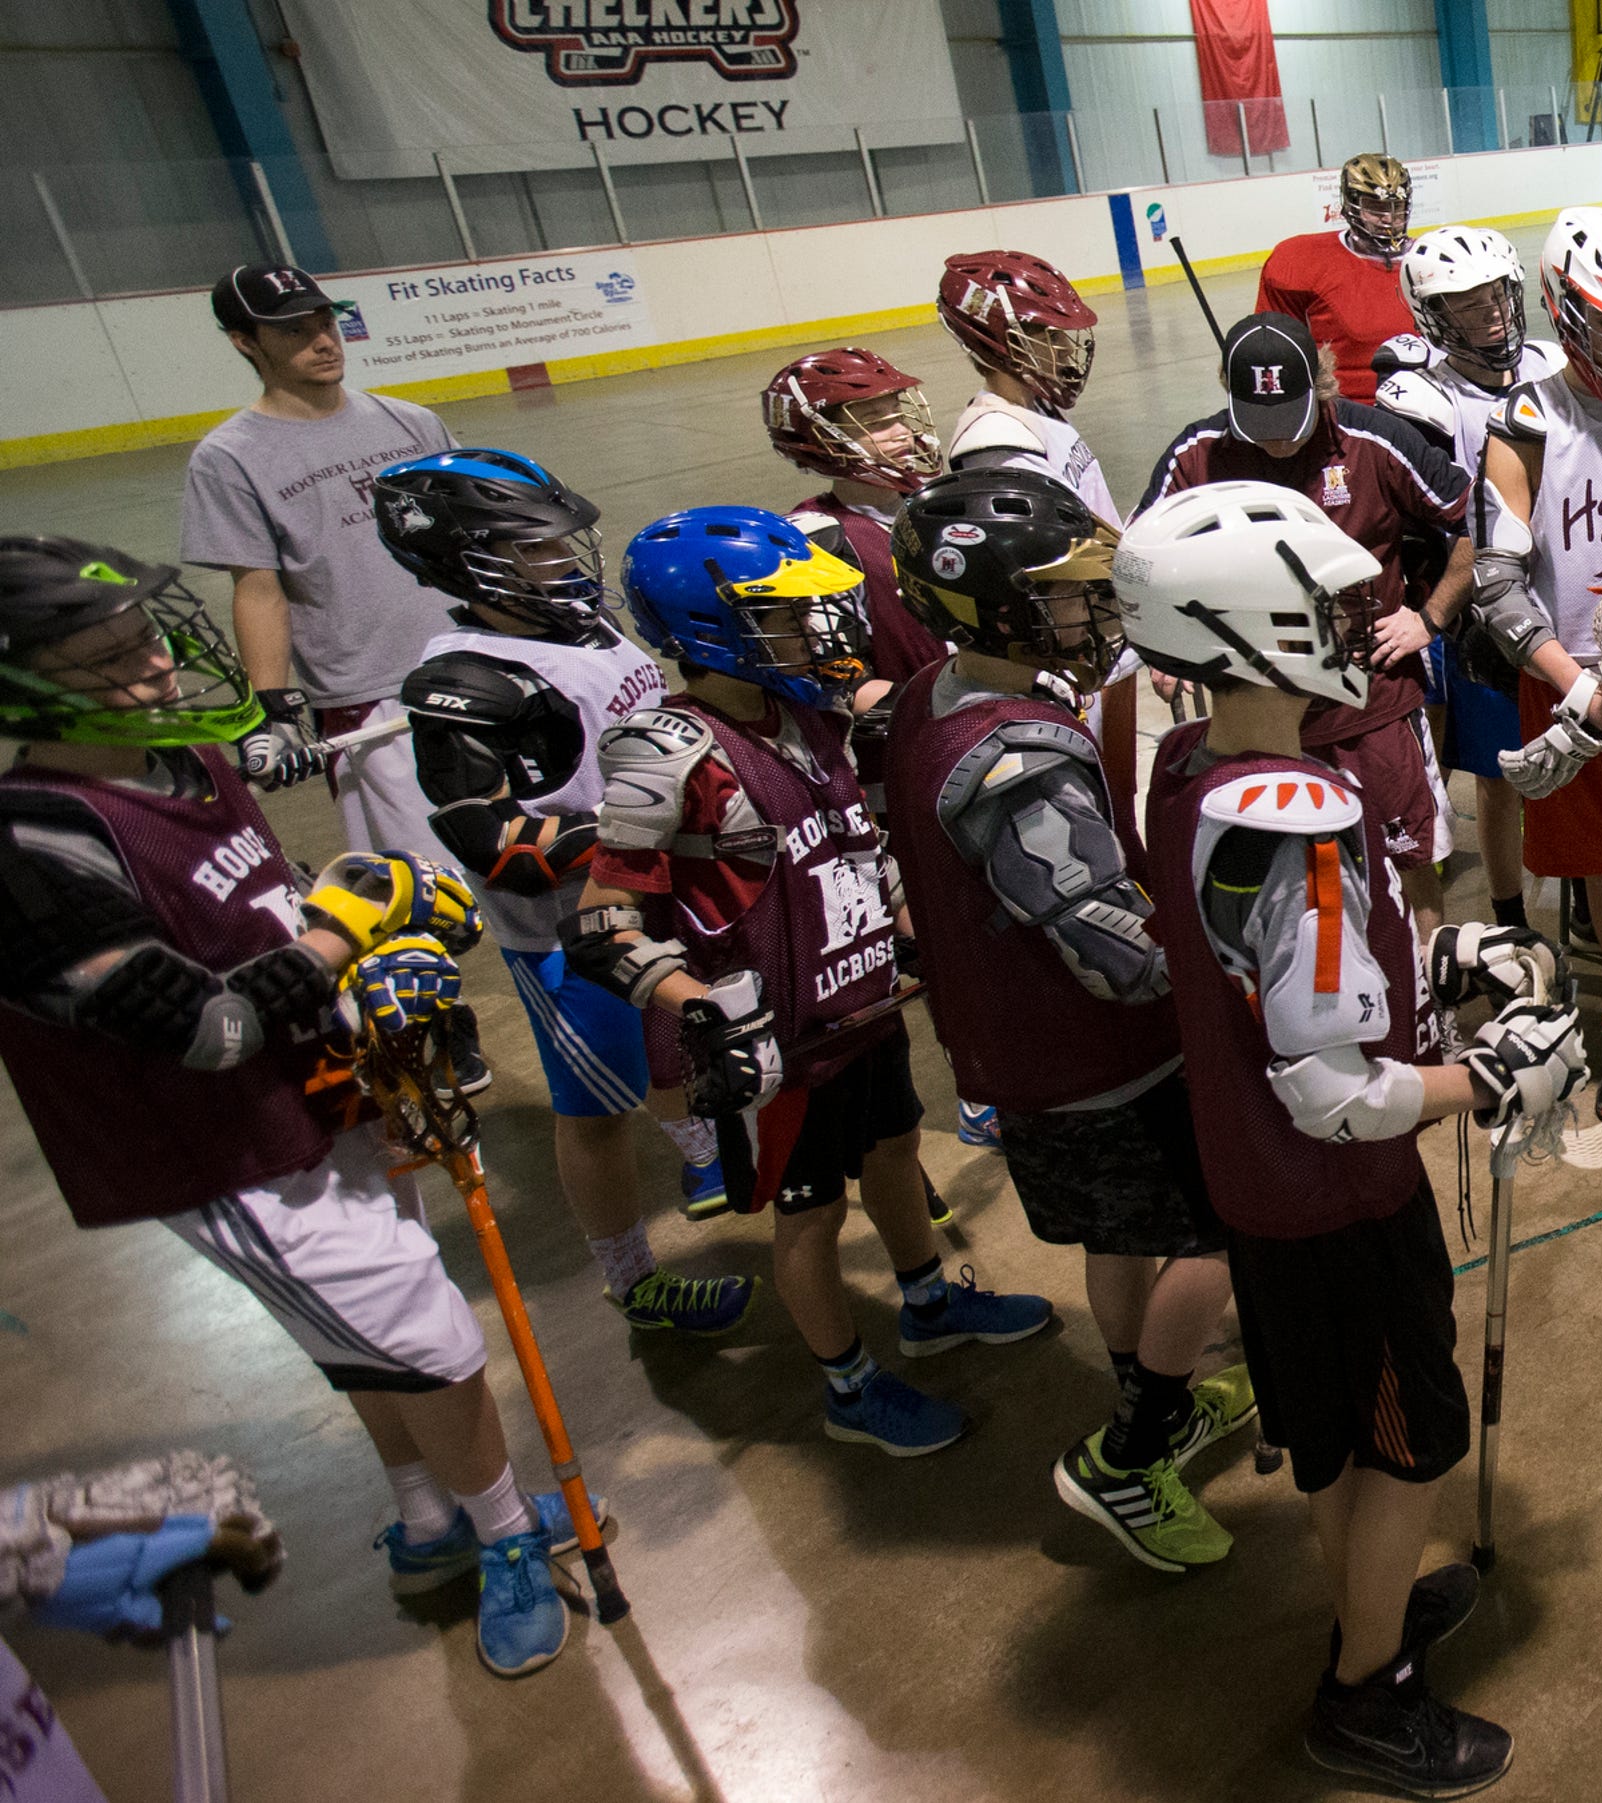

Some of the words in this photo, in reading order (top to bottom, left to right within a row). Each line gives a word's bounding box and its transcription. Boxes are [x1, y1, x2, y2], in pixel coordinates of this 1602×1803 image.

[592, 31, 644, 45] AAA
[652, 30, 746, 44] HOCKEY
[571, 99, 790, 141] HOCKEY
[387, 282, 420, 300] Fit
[425, 273, 515, 297] Skating
[518, 266, 576, 286] Facts
[385, 336, 402, 347] 55
[404, 333, 434, 345] Laps
[448, 324, 495, 339] Skating
[496, 322, 509, 332] to
[510, 314, 572, 330] Monument
[573, 309, 603, 321] Circle
[424, 314, 439, 324] 11
[441, 311, 470, 323] Laps
[482, 303, 527, 317] Skating
[529, 302, 535, 311] 1
[538, 299, 562, 310] mile
[362, 358, 369, 367] 1
[372, 354, 402, 366] Hour
[404, 351, 417, 361] of
[419, 345, 463, 360] Skating
[464, 341, 497, 353] Burns
[499, 340, 513, 348] an
[514, 333, 557, 345] Average
[559, 329, 570, 339] of
[571, 327, 591, 337] 700
[592, 322, 632, 335] Calories
[278, 463, 348, 501] HOOSIER
[348, 444, 425, 471] LACROSSE
[424, 692, 473, 711] STX
[1439, 954, 1450, 985] Reebok
[1507, 1032, 1538, 1064] Reebok
